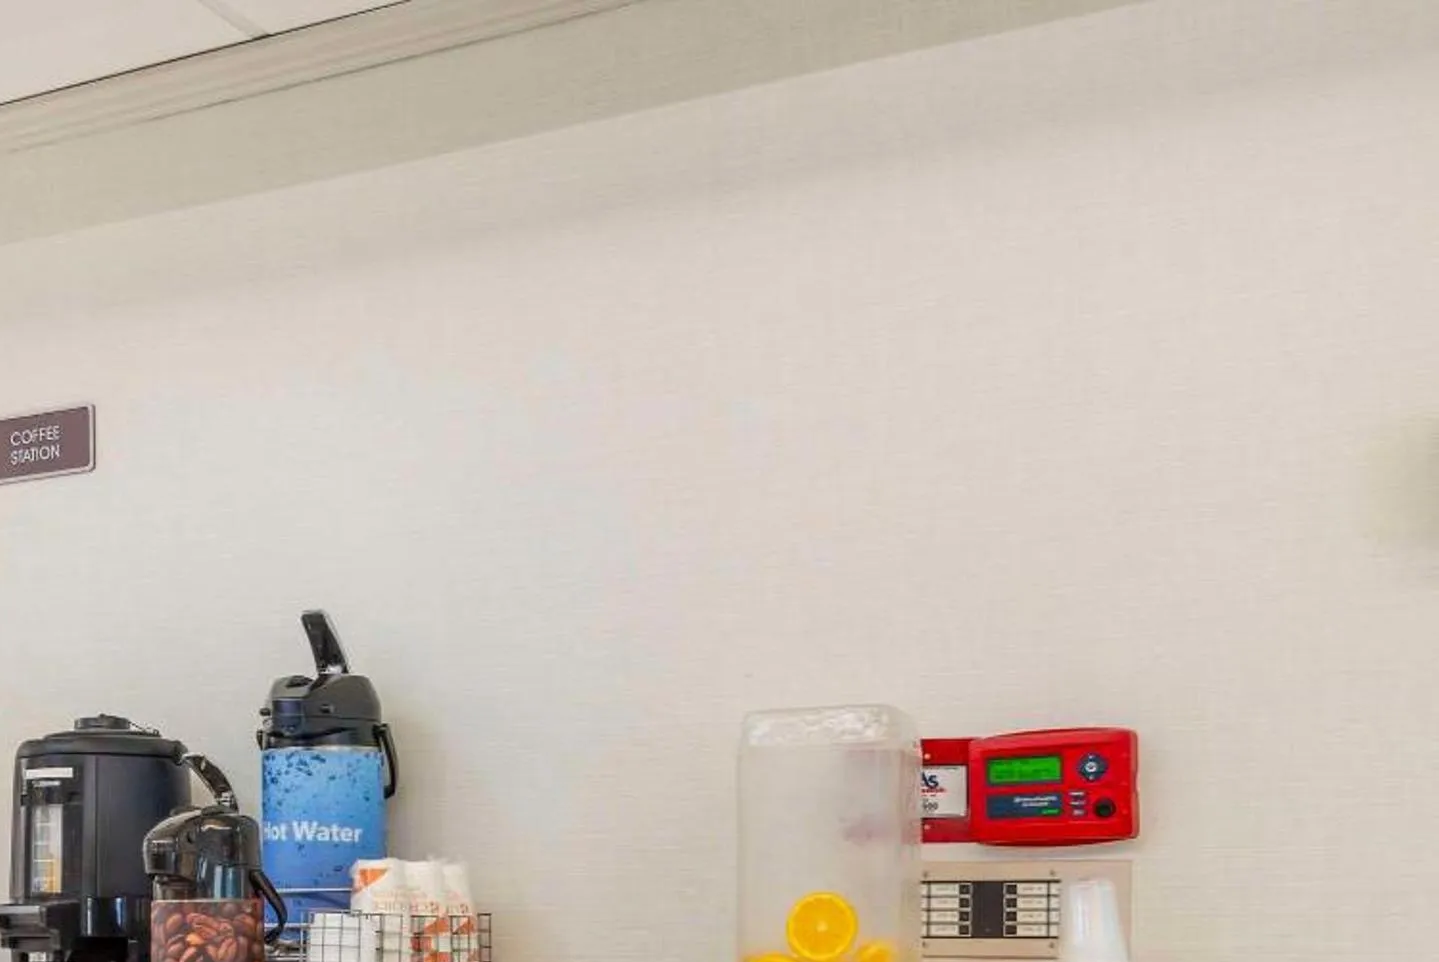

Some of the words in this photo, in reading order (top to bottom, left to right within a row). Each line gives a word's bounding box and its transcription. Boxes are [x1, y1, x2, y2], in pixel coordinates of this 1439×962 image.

[10, 425, 61, 447] COFFEE
[10, 444, 61, 465] STATION
[291, 819, 364, 843] Water
